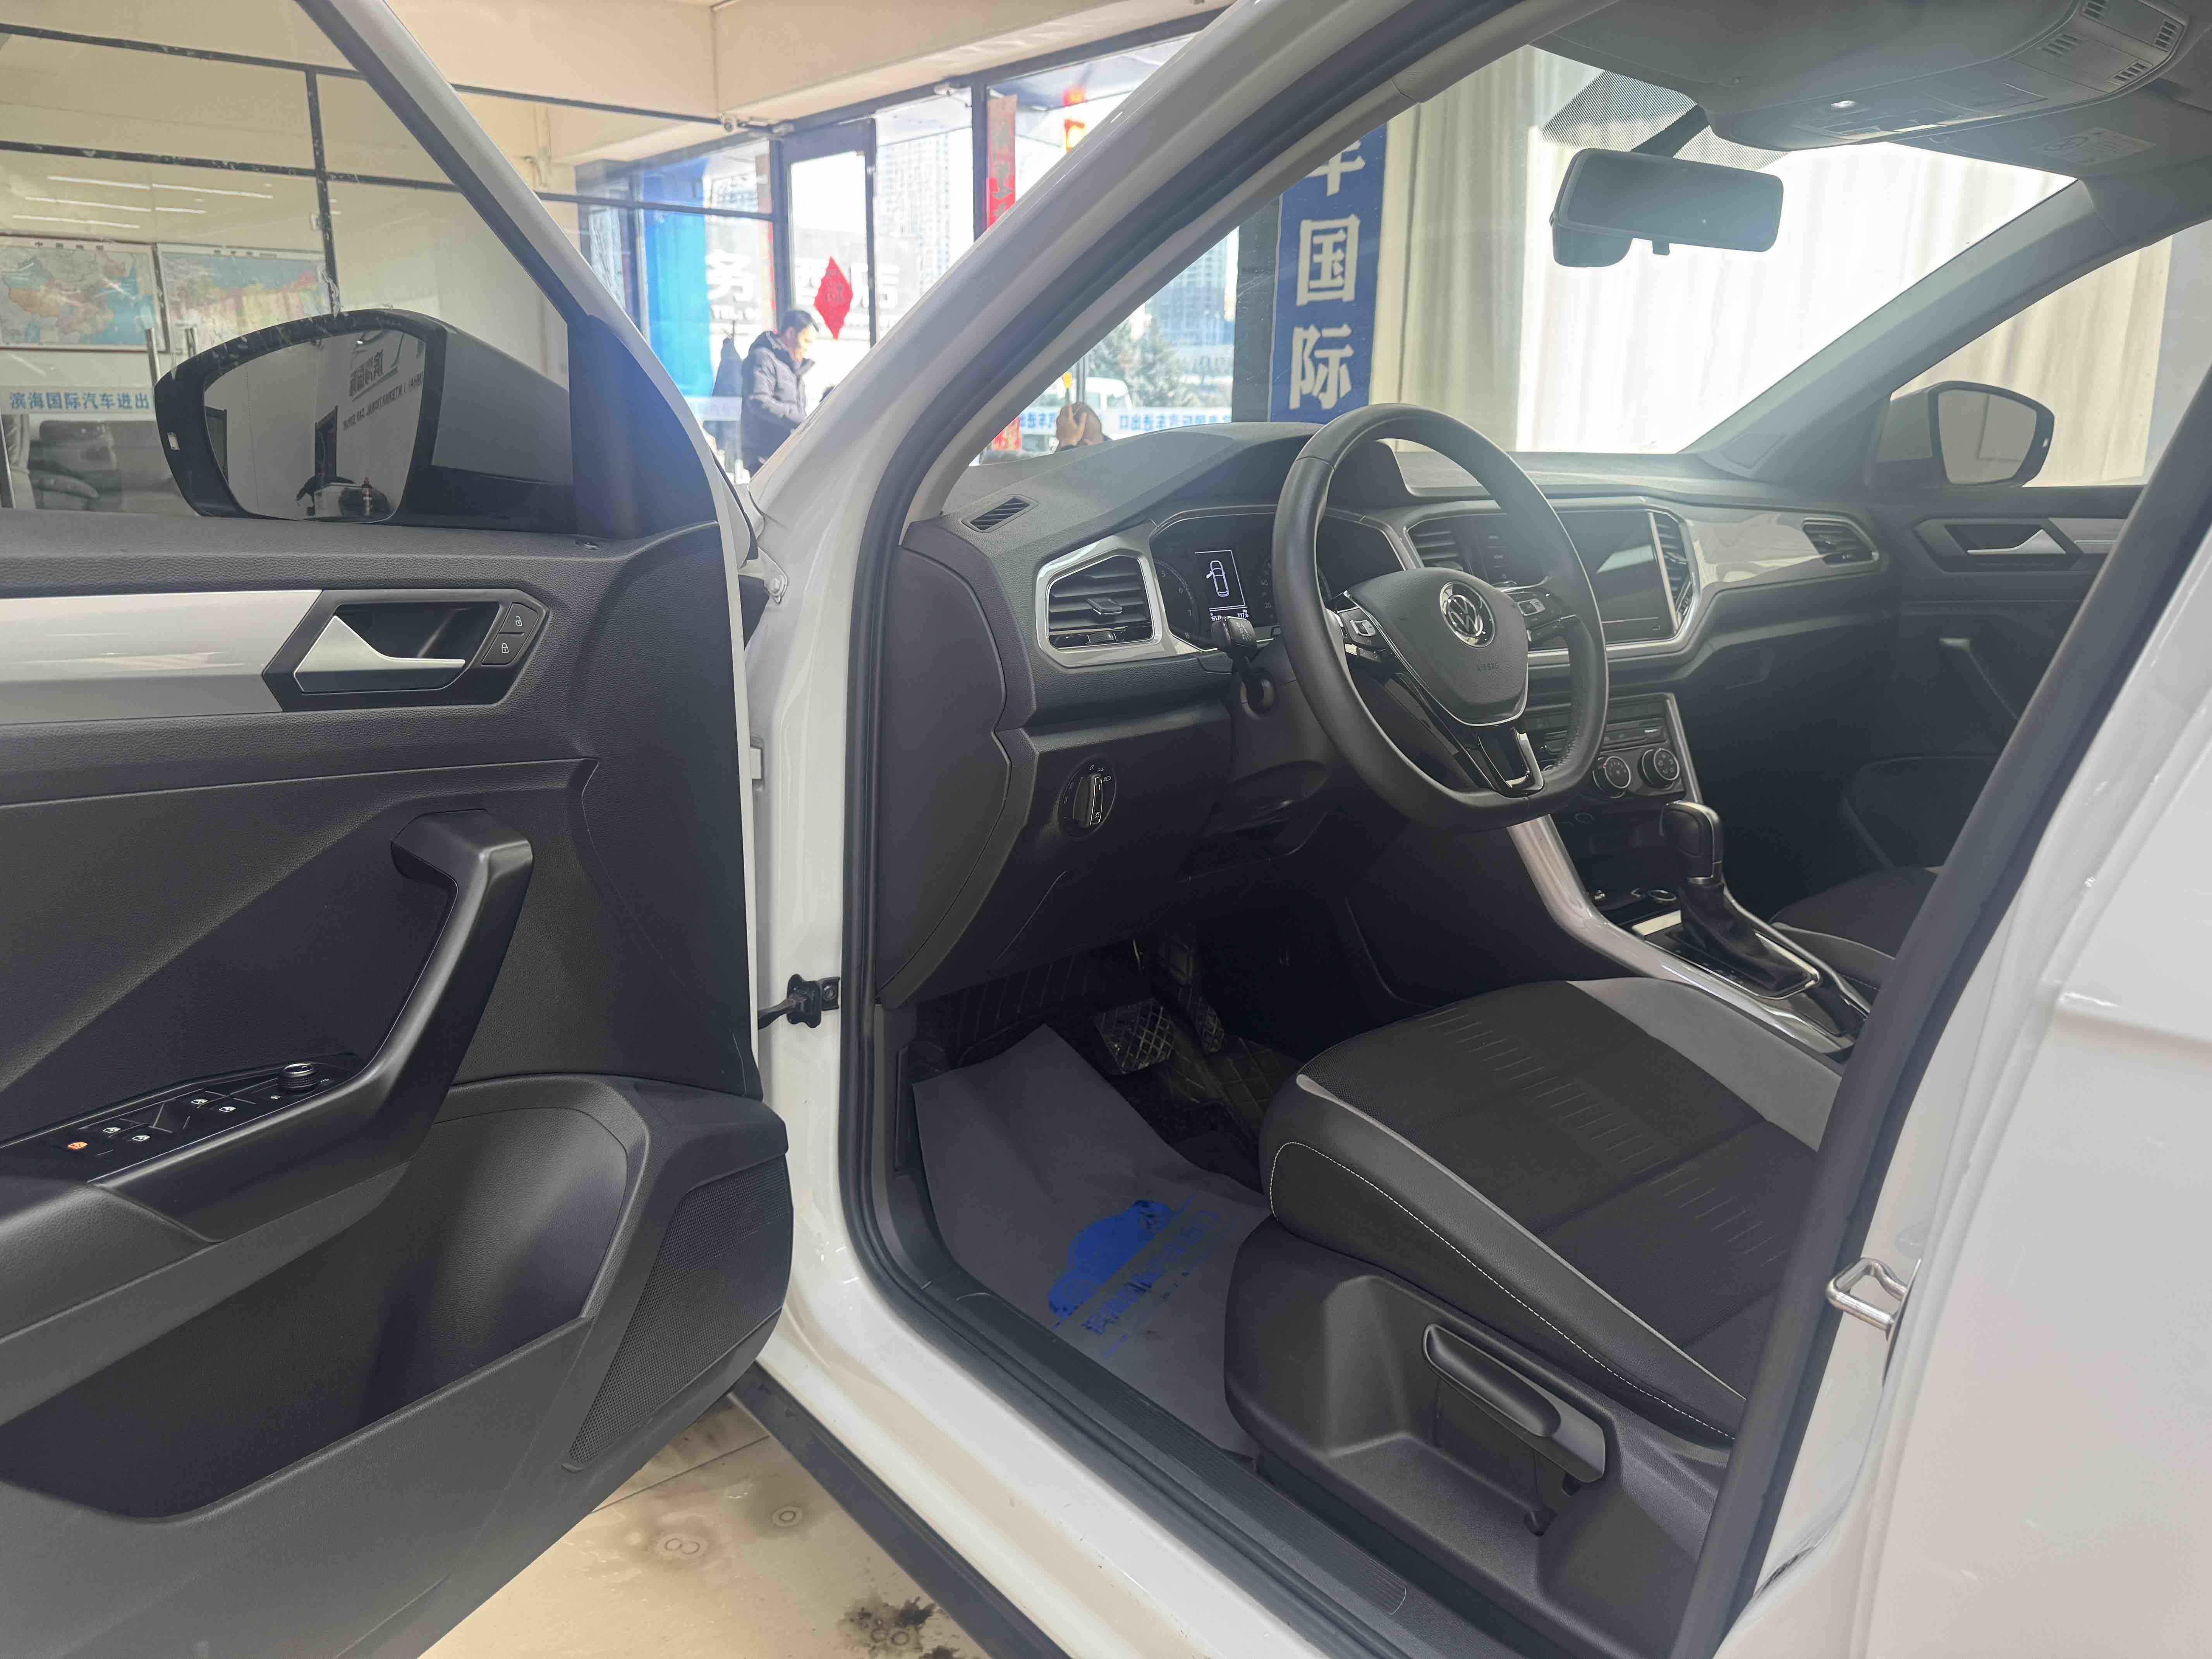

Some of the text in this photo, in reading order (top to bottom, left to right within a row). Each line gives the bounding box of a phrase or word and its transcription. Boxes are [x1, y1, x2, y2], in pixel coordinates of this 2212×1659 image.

[10, 392, 149, 410] 滨海国际汽车进出
